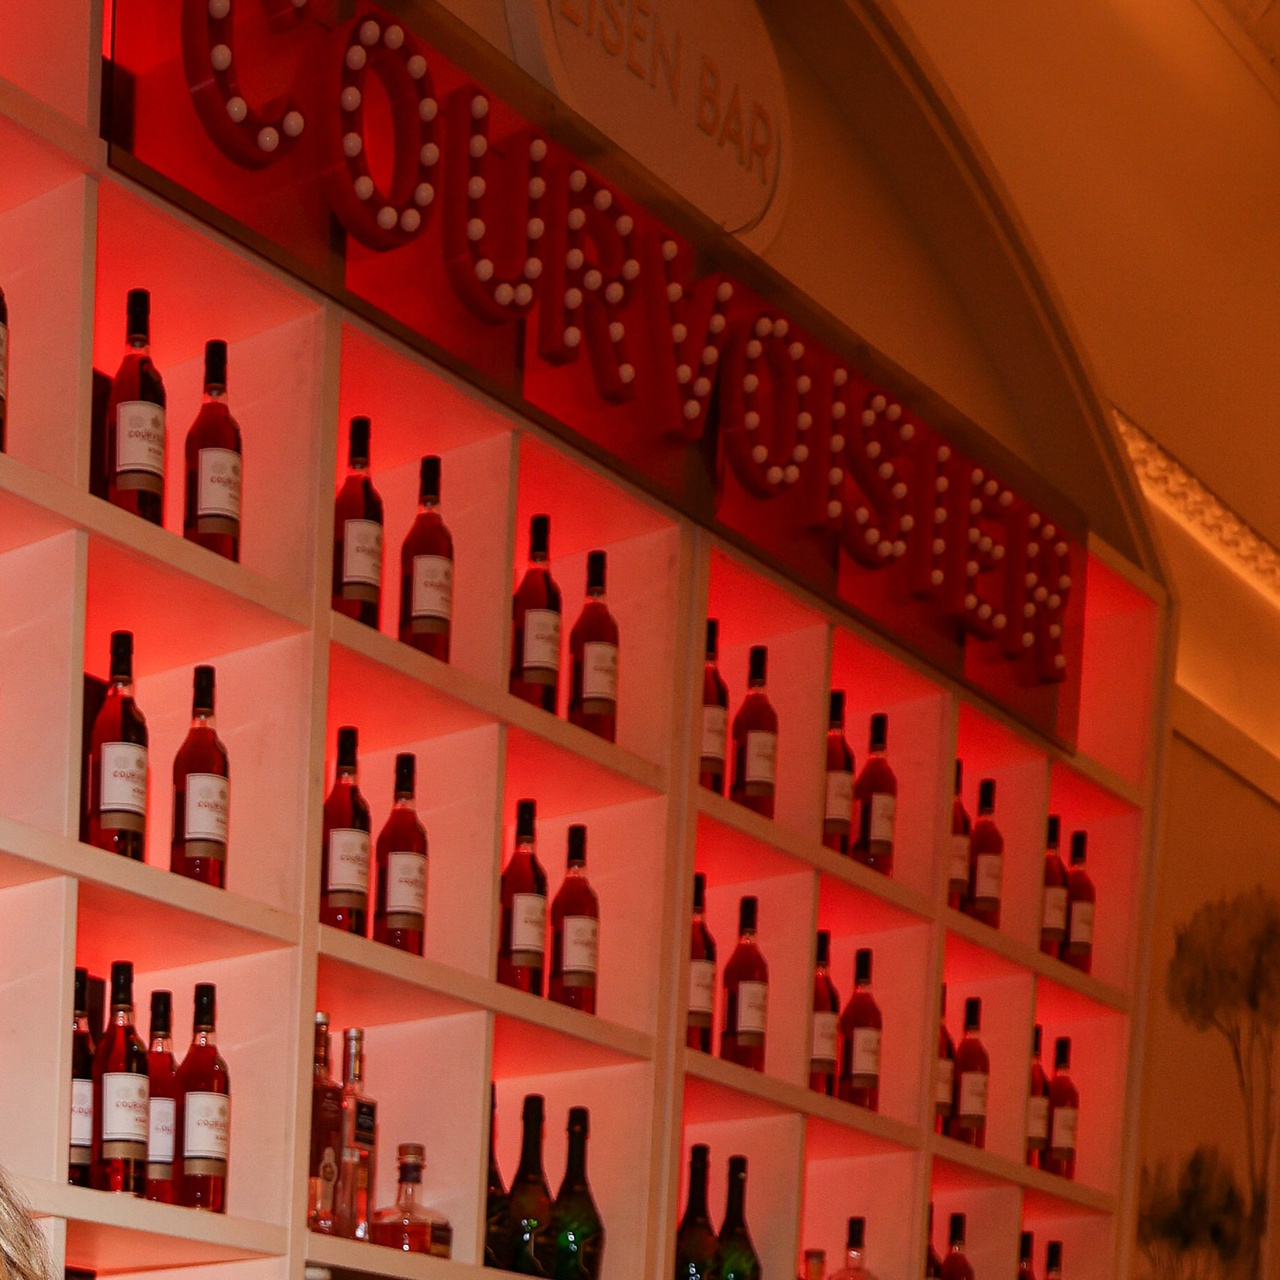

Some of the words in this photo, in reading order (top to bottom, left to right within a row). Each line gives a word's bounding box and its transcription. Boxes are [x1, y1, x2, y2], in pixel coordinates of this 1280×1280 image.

[560, 0, 683, 106] ISEN
[697, 54, 772, 186] BAR
[182, 0, 1070, 685] COURVOISIER
